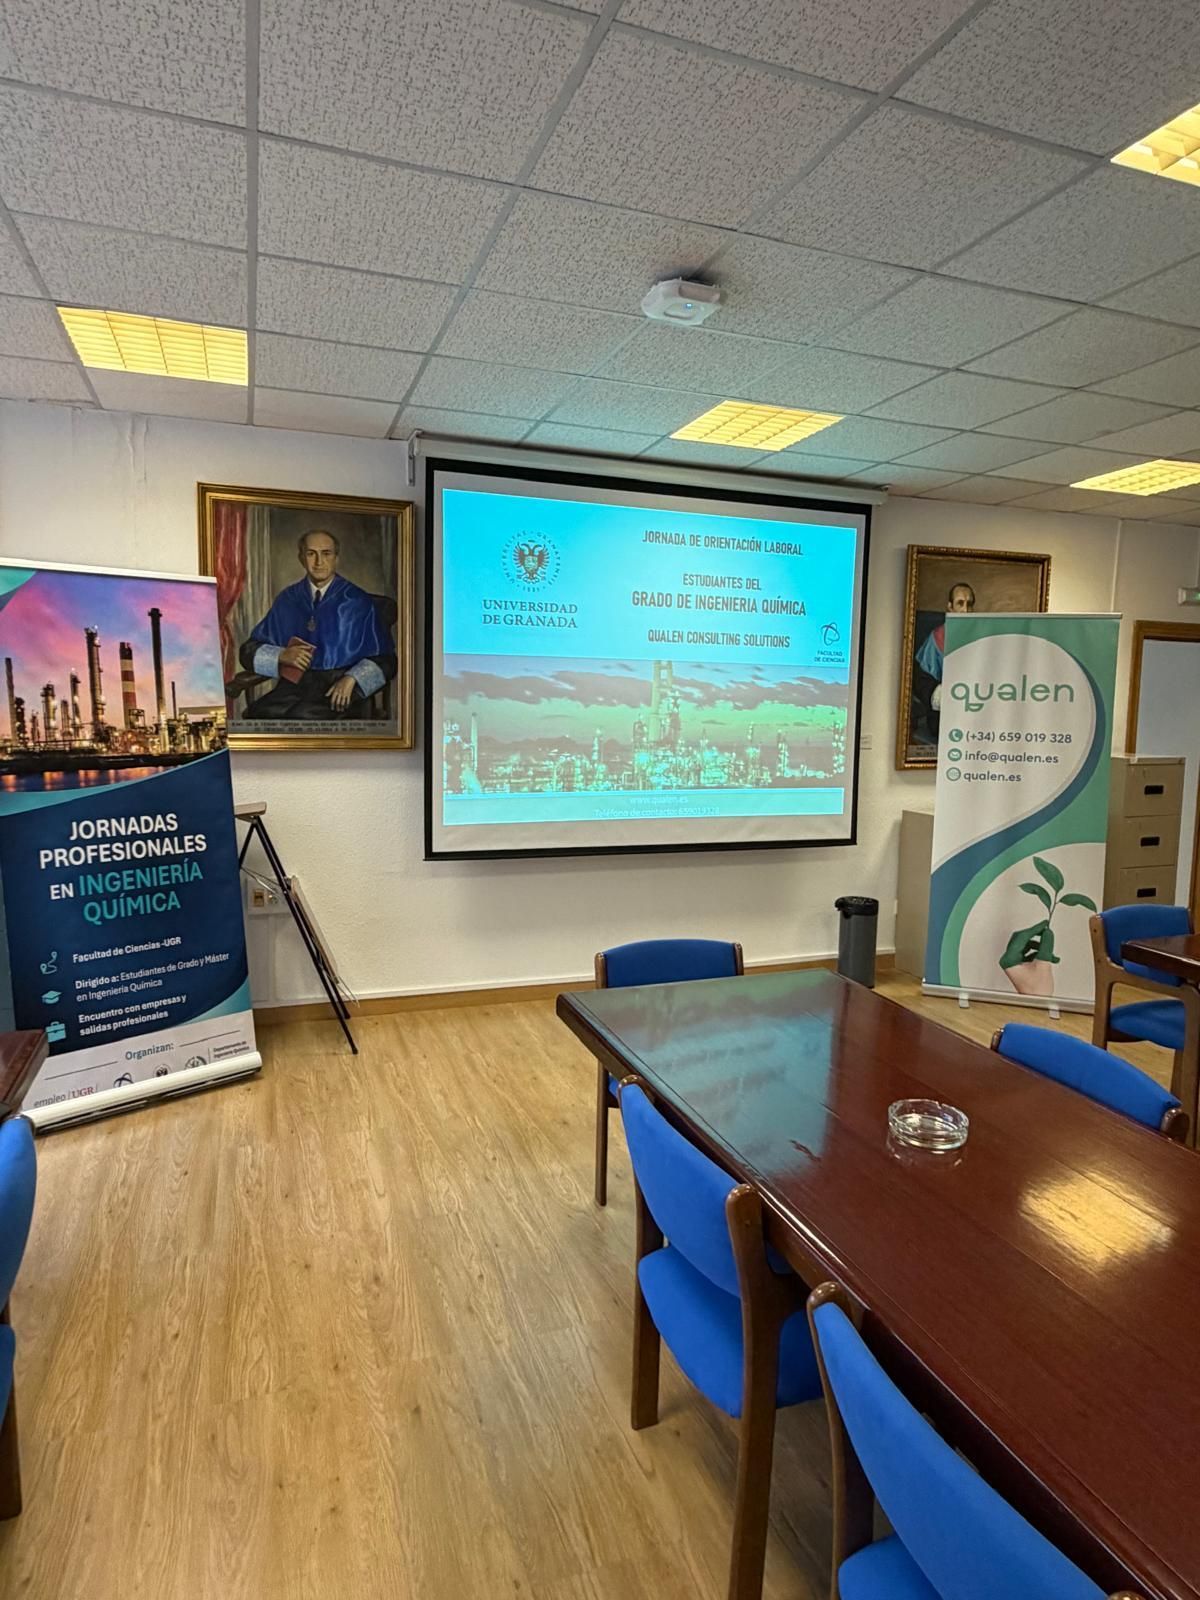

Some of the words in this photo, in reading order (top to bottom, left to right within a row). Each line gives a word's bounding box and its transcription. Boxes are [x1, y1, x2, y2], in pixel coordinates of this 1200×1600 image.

[642, 530, 687, 546] JORNADA
[689, 534, 700, 547] DE
[703, 535, 761, 552] ORIENTACIÓN
[764, 541, 803, 556] LABORAL
[683, 573, 743, 589] ESTUDIANTES
[745, 578, 762, 591] DEL
[482, 599, 578, 614] UNIVERSIDAD
[632, 590, 673, 608] GRADO
[676, 593, 692, 609] DE
[695, 595, 758, 613] INGENIERIA
[761, 595, 807, 616] QUÍMICA
[482, 614, 501, 625] DE
[503, 614, 578, 628] GRANADA
[647, 629, 684, 644] QUALEN
[686, 631, 741, 646] CONSULTING
[743, 634, 791, 648] SOLUTIONS
[950, 674, 1075, 712] qualen
[966, 731, 996, 743] (+34)
[999, 732, 1022, 742] 659
[1025, 733, 1046, 743] 019
[1050, 733, 1072, 744] 328
[964, 750, 1059, 764] info@qualen.es
[963, 770, 1022, 782] qualen.es
[69, 812, 178, 841] JORNADAS
[39, 834, 207, 869] PROFESIONALES
[50, 882, 74, 900] EN
[79, 858, 204, 896] INGENIERÍA
[83, 890, 181, 925] QUÍMICA
[72, 948, 112, 963] Facultad
[112, 947, 124, 956] de
[75, 976, 110, 989] Dirigido
[111, 975, 120, 983] a:
[120, 966, 166, 981] Estudiantes
[166, 963, 177, 972] de
[177, 958, 200, 970] Grado
[199, 958, 204, 967] y
[204, 953, 230, 964] Máster
[76, 994, 88, 1002] en
[78, 1008, 123, 1023] Encuentro
[124, 1004, 141, 1014] con
[141, 995, 181, 1009] empresas
[181, 994, 187, 1003] y
[80, 1021, 112, 1036] salidas
[112, 1010, 169, 1031] profesionales
[125, 1042, 174, 1061] Organizan:
[71, 1086, 95, 1099] UGR
